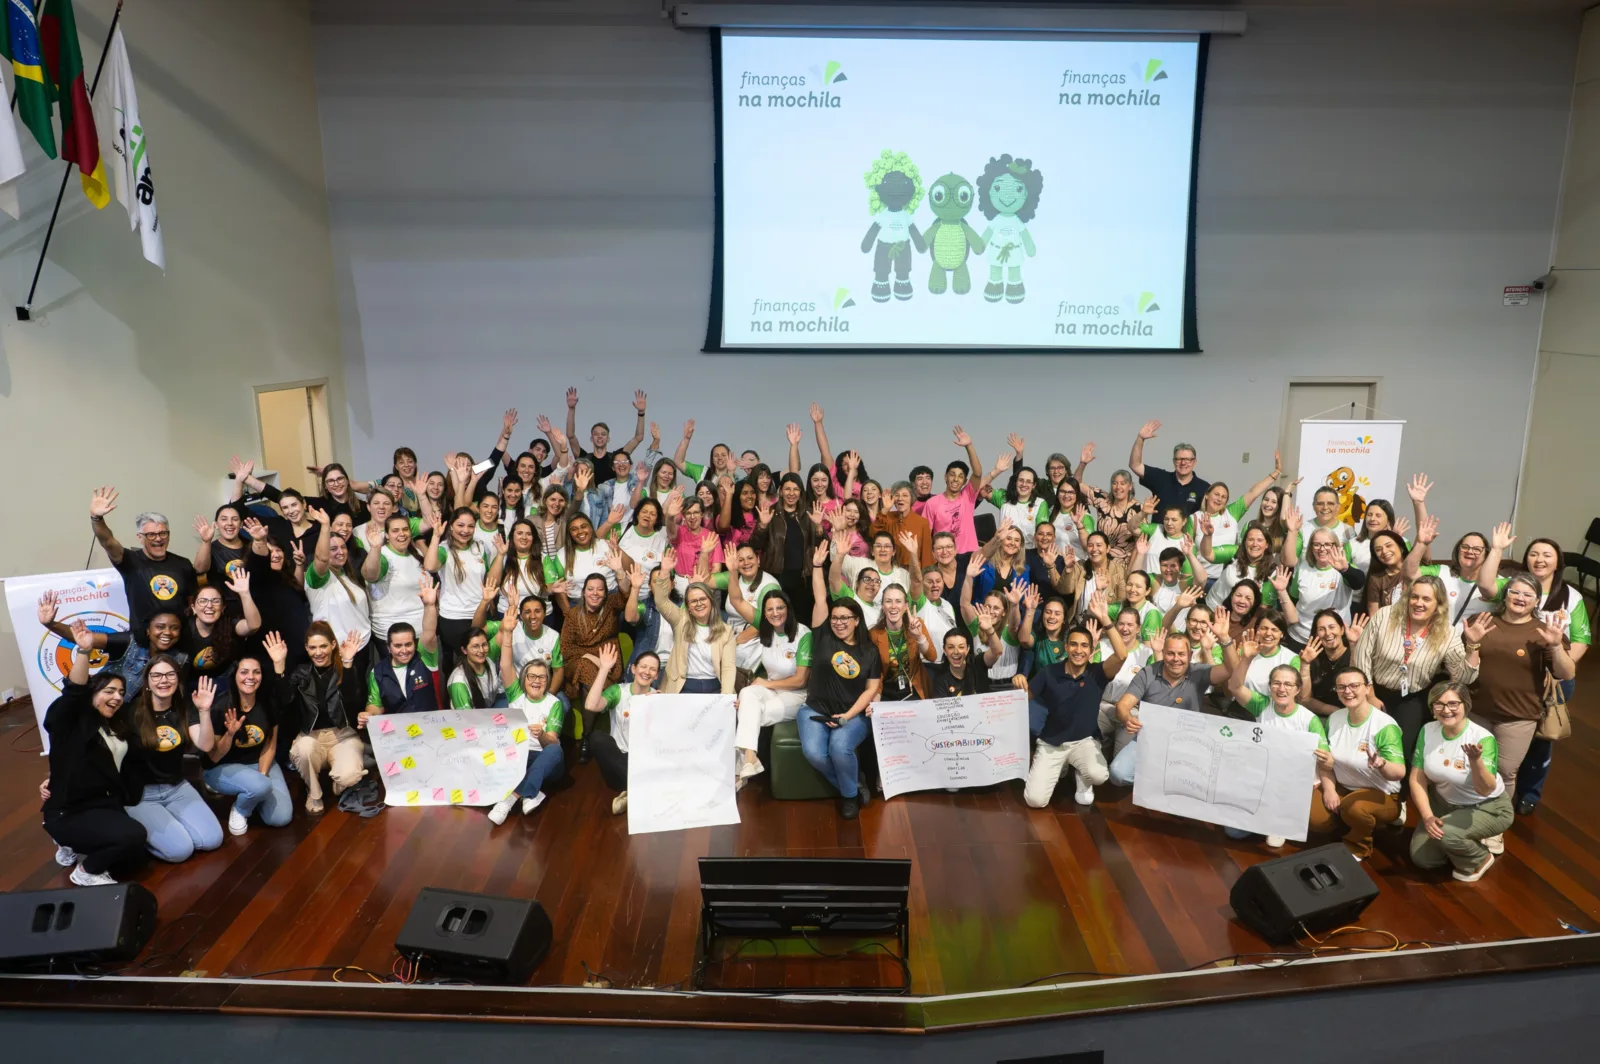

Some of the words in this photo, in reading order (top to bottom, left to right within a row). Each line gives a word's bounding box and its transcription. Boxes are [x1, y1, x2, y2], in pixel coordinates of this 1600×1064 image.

[740, 71, 806, 89] finanças
[1061, 70, 1126, 88] finanças
[739, 94, 761, 107] na
[768, 91, 841, 108] mochila
[1059, 92, 1081, 105] na
[1087, 89, 1161, 106] mochila
[752, 298, 816, 315] finanças
[1057, 301, 1120, 318] finanças
[751, 320, 773, 332] na
[779, 316, 850, 332] mochila
[1055, 322, 1077, 335] na
[1082, 320, 1153, 336] mochila
[1338, 446, 1371, 454] mochila
[65, 591, 110, 604] mochila
